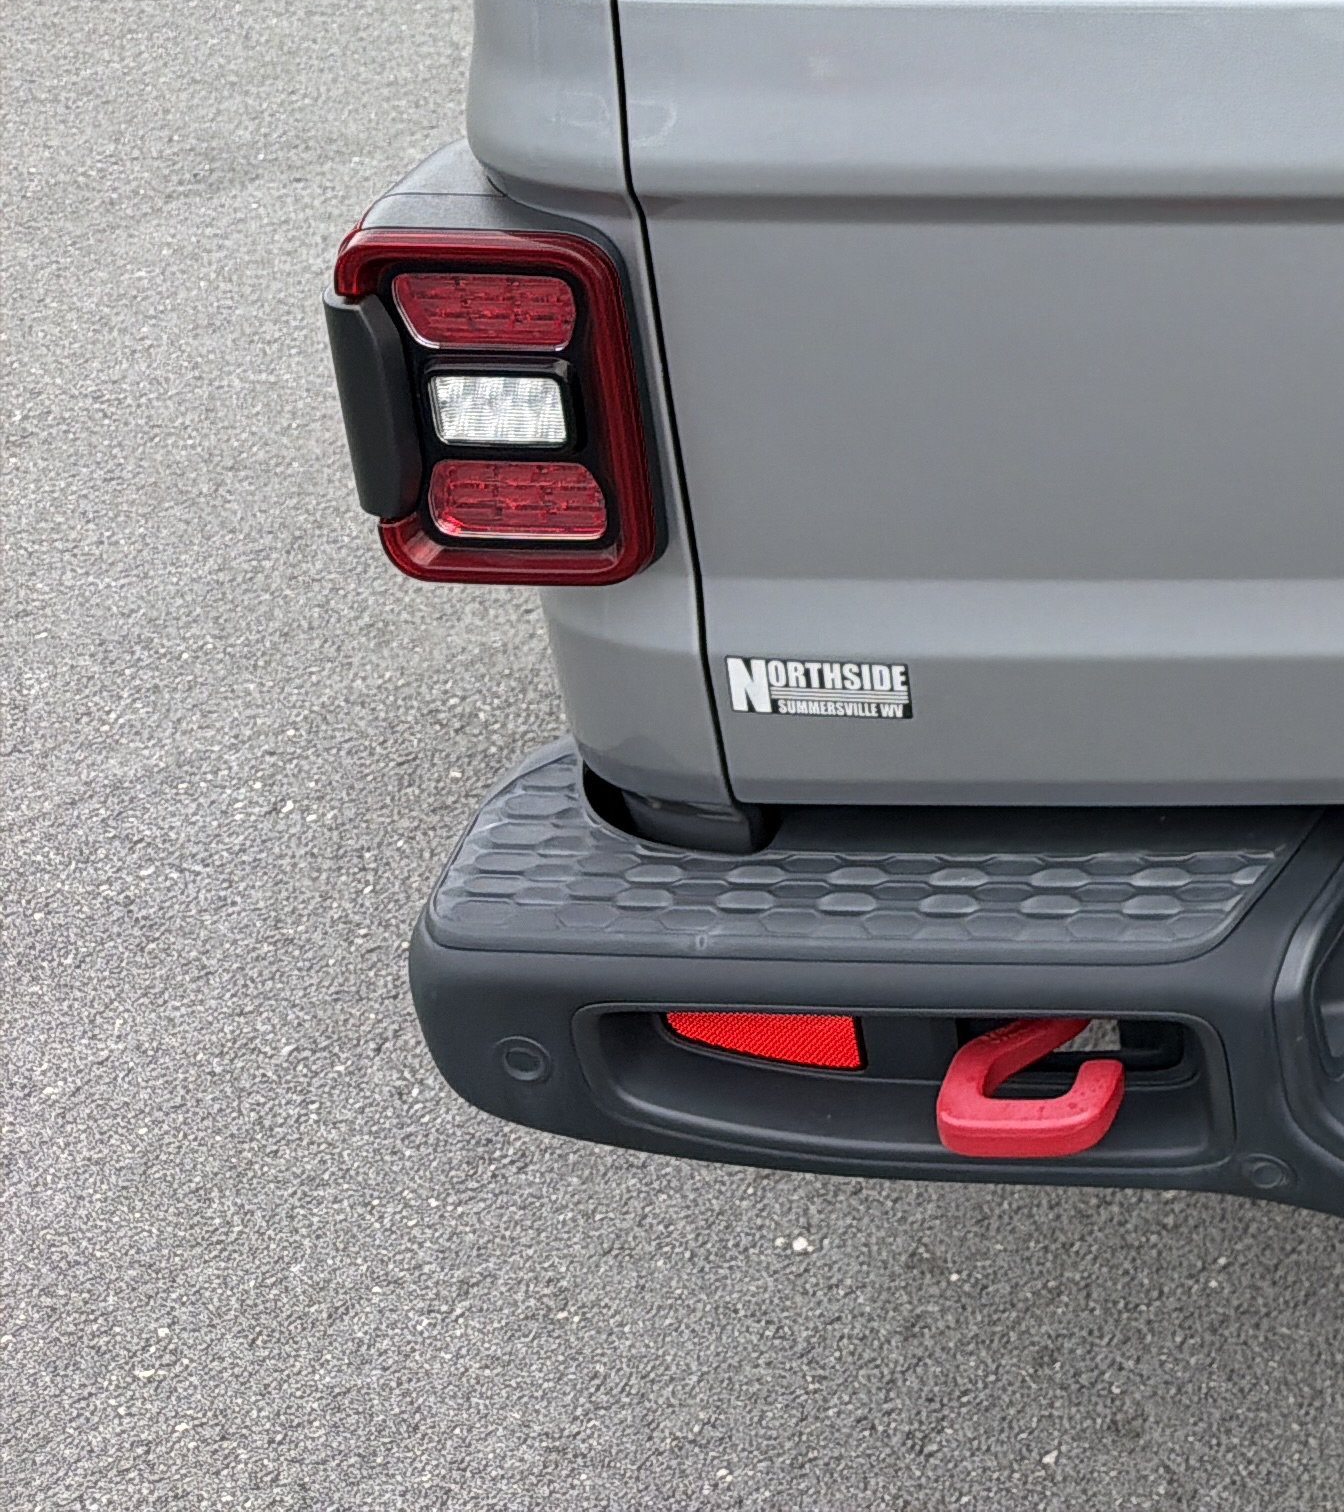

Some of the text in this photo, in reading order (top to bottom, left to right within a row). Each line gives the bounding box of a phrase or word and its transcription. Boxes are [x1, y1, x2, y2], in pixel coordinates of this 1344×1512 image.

[726, 657, 909, 713] NORTHSIDE
[778, 699, 904, 718] SUMMERSVILLE WV
